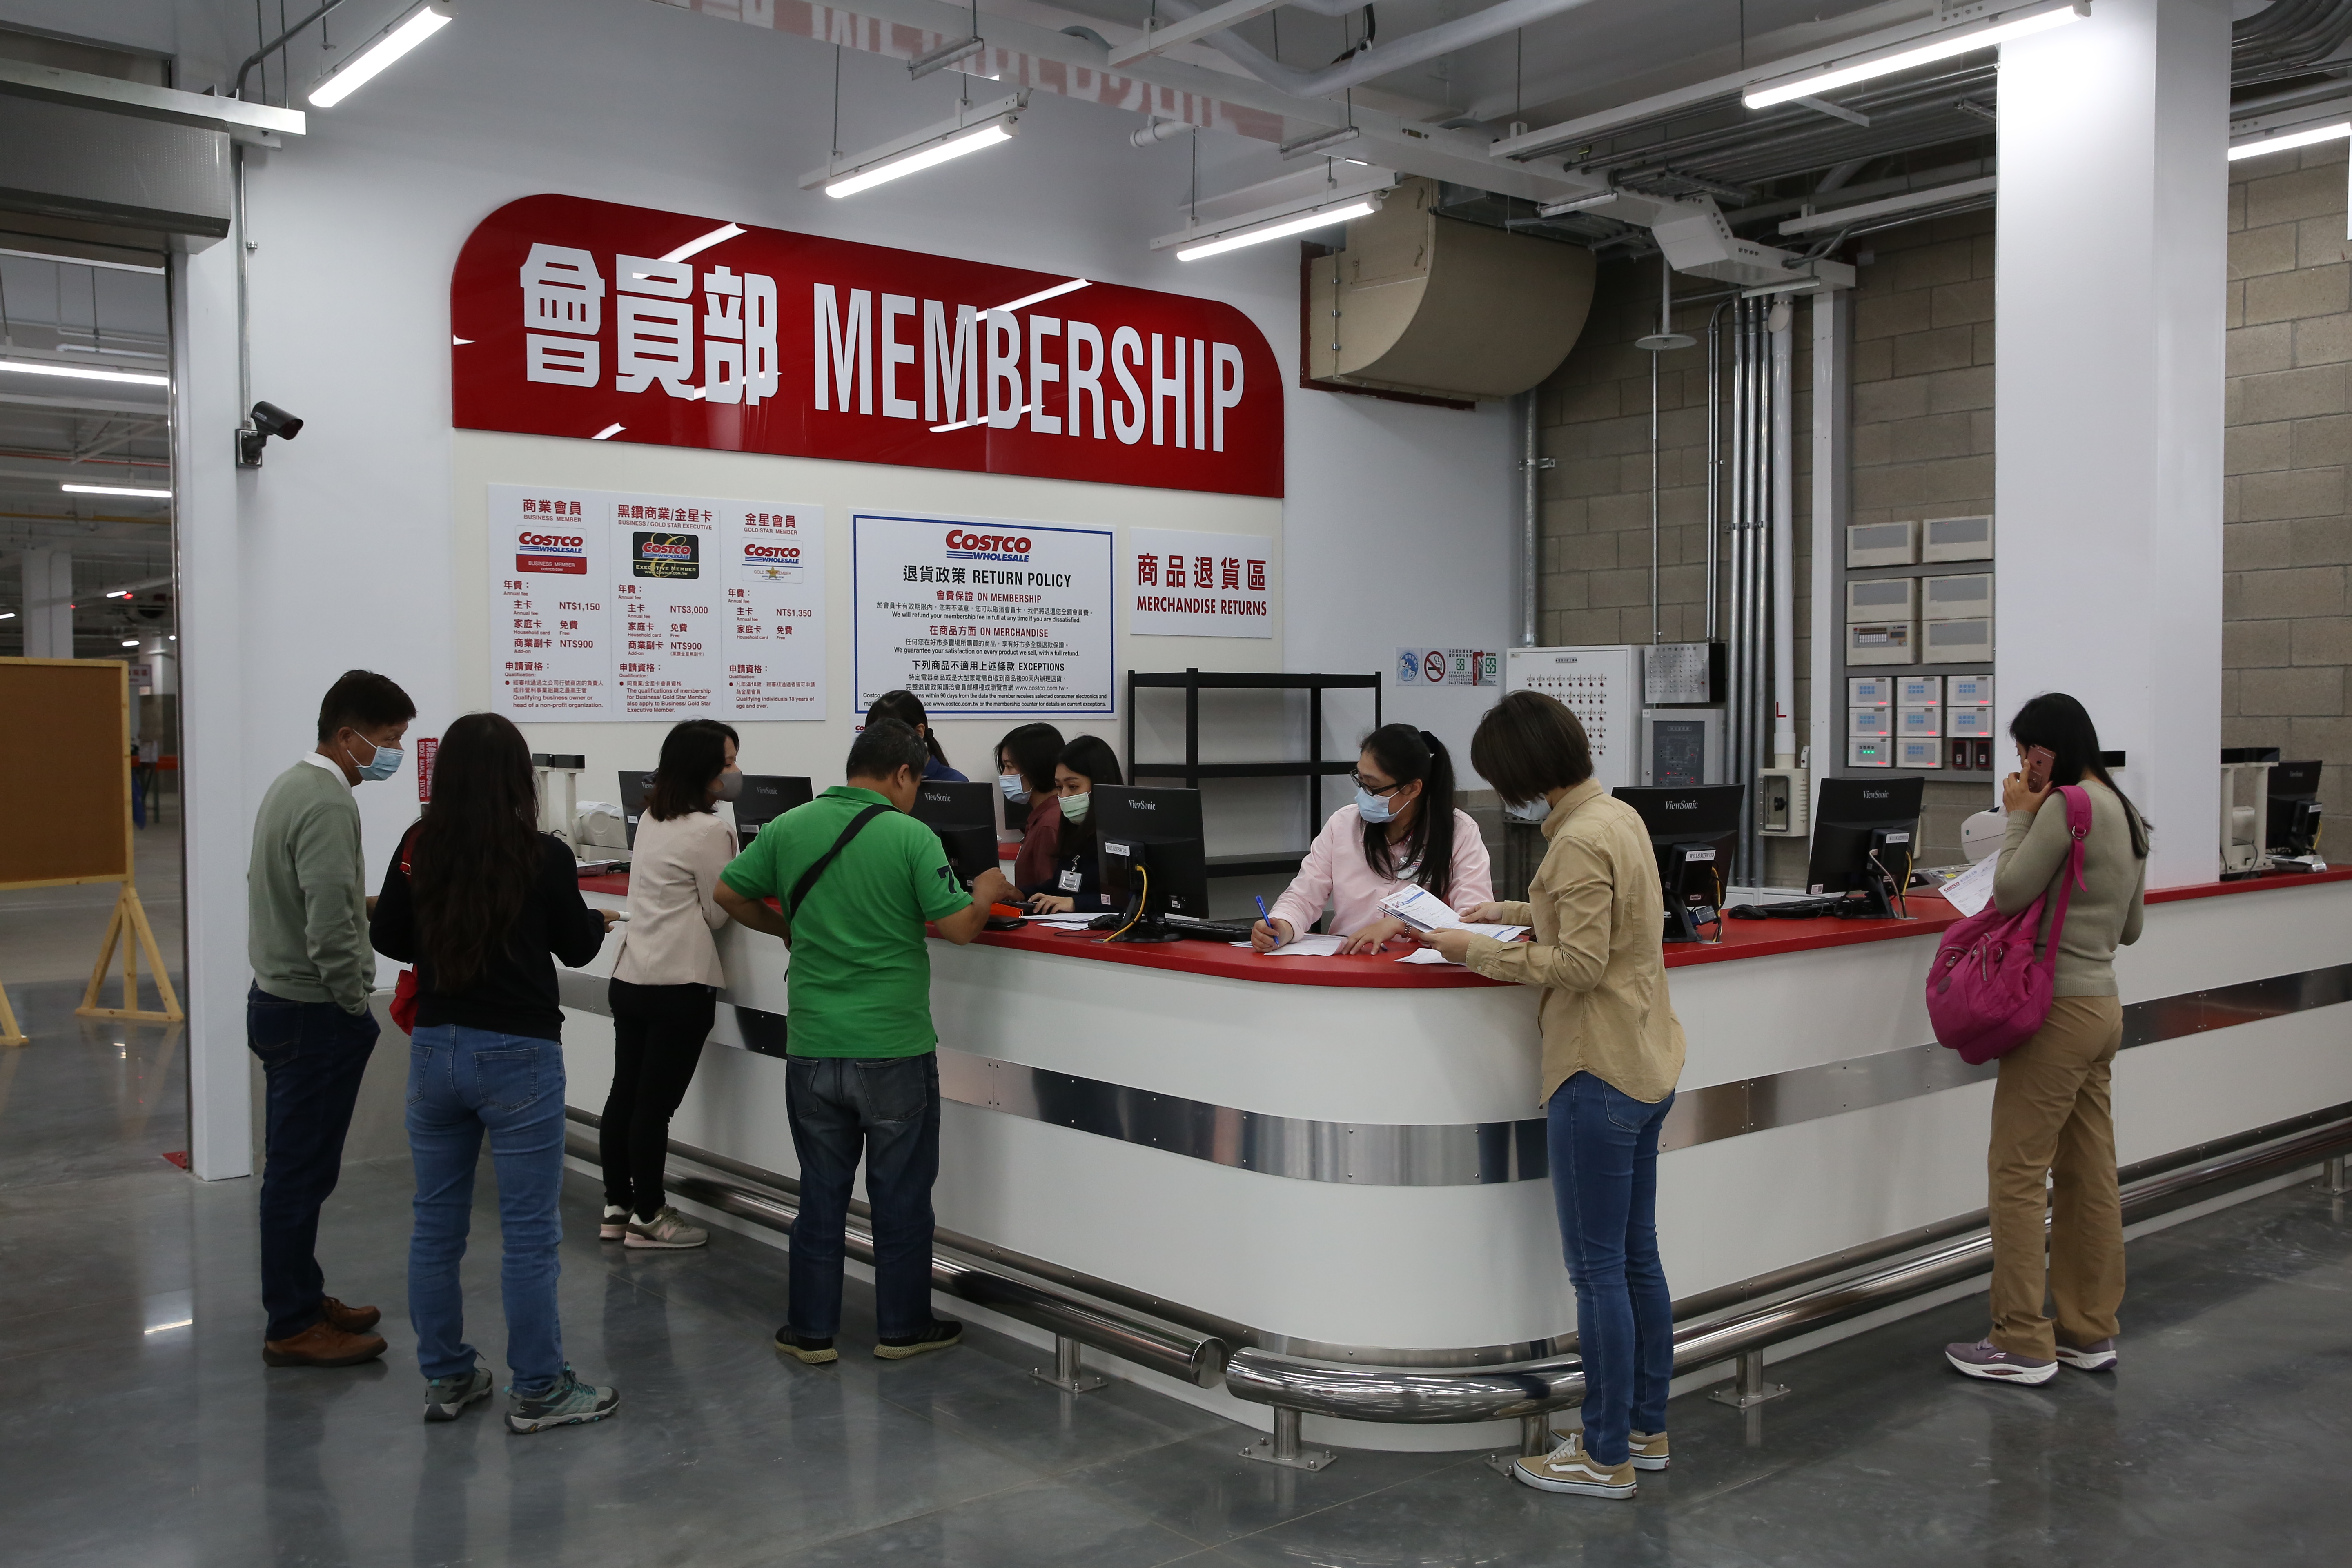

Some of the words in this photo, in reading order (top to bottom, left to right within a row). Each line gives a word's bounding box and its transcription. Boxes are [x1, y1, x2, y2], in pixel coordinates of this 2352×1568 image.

[519, 242, 778, 406] 會員部
[814, 283, 1244, 452] MEMBERSHIP
[523, 499, 581, 516] 商業會員
[618, 504, 713, 523] 黑鑽商業/金星卡
[745, 513, 795, 528] 金星會員
[519, 532, 583, 547] COSTCO
[946, 529, 1031, 553] COSTCO
[642, 542, 691, 554] COSTCO
[744, 544, 800, 557] COSTCO
[972, 552, 1029, 562] WHOLESALE
[903, 565, 966, 584] 退貨政策
[973, 570, 1022, 586] RETURN
[1028, 572, 1071, 587] POLICY
[1138, 553, 1266, 591] 商品退貨區
[936, 590, 973, 601] 會費保證
[978, 592, 988, 601] ON
[991, 593, 1042, 603] MEMBERSHIP
[514, 600, 532, 609] 主卡
[559, 601, 600, 611] NT$1,150
[628, 604, 645, 612] 主卡
[1137, 596, 1216, 613] MERCHANDISE
[1221, 599, 1267, 616] RETURNS
[670, 605, 708, 615] NT$3,000
[737, 607, 753, 616] 主卡
[776, 608, 812, 618] NT$1,350
[943, 613, 976, 621] membership
[514, 619, 542, 628] 家庭卡
[560, 620, 578, 630] 免費
[628, 622, 654, 631] 家庭卡
[671, 623, 687, 632] 免費
[737, 625, 761, 634] 家庭卡
[777, 626, 792, 635] 免費
[930, 625, 976, 636] 在商品方面
[980, 627, 991, 636] ON
[994, 628, 1049, 637] MERCHANDISE
[514, 638, 552, 648] 商業副卡
[560, 640, 593, 649] NT$900
[628, 641, 664, 650] 商業副卡
[670, 642, 702, 651] NT$900
[912, 660, 1015, 671] 下列商品不適用上述條款
[1018, 662, 1065, 671] EXCEPTIONS
[924, 793, 951, 802] ViewSonic
[1863, 790, 1889, 798] ViewSonic
[1128, 800, 1156, 810] ViewSonic
[1665, 800, 1698, 810] ViewSonic
[937, 864, 958, 894] 7
[1944, 882, 1960, 892] COSTCO
